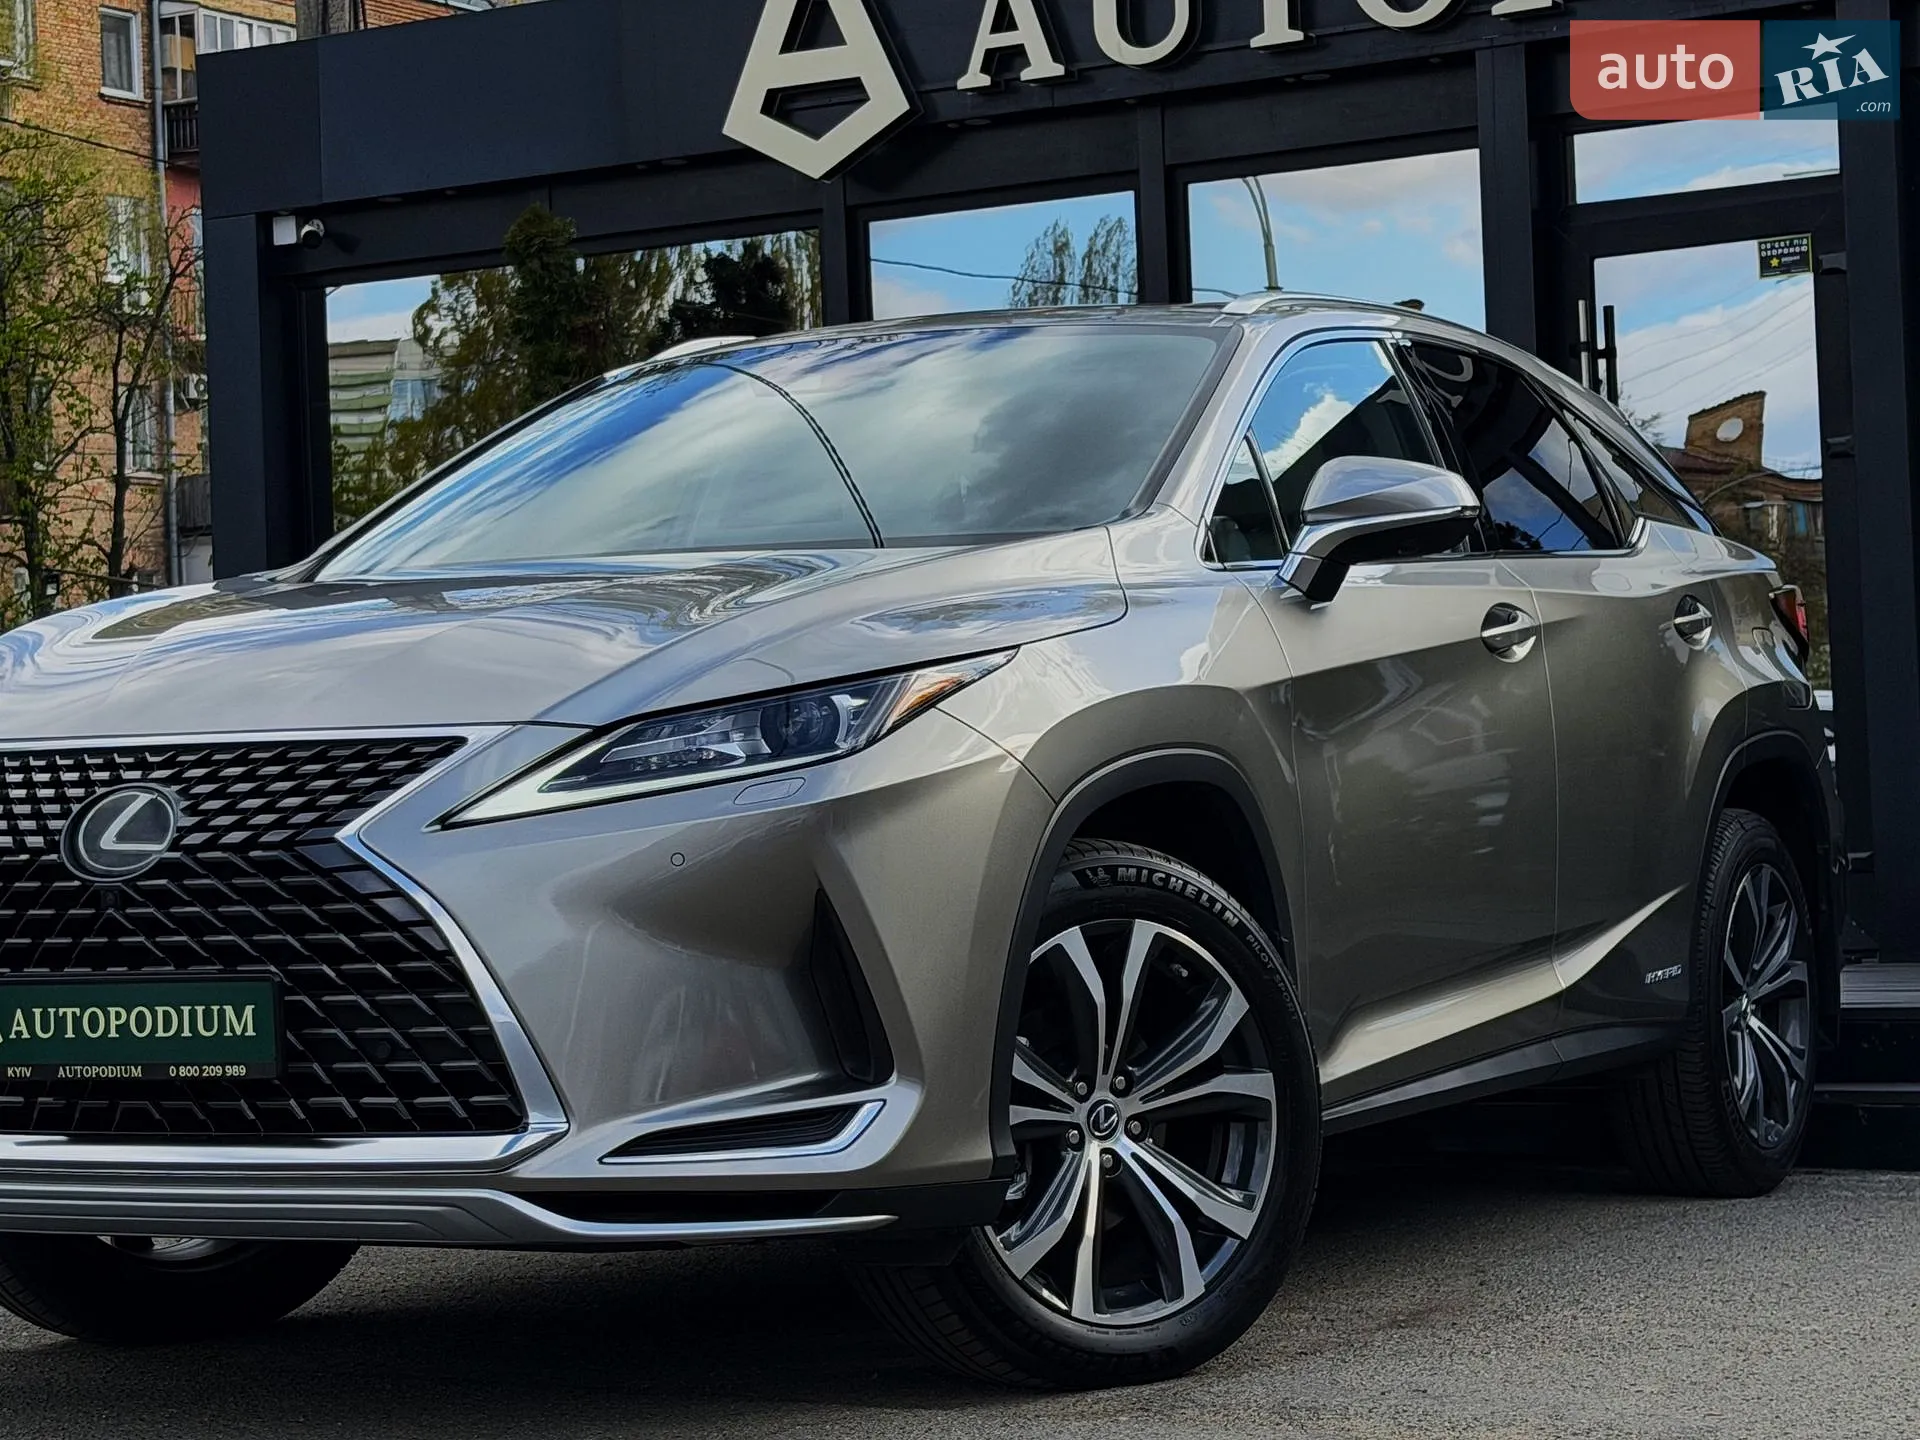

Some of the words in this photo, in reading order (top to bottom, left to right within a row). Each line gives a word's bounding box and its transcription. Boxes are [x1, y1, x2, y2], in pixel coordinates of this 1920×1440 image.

[1117, 867, 1241, 928] MICHELIN
[1246, 934, 1275, 969] PILOT
[9, 1005, 257, 1039] AUTOPODIUM
[7, 1066, 32, 1078] KYIV
[57, 1065, 143, 1078] AUTOPODIUM
[169, 1066, 176, 1077] 0
[178, 1066, 200, 1077] 800
[202, 1066, 223, 1077] 209
[225, 1065, 247, 1077] 989
